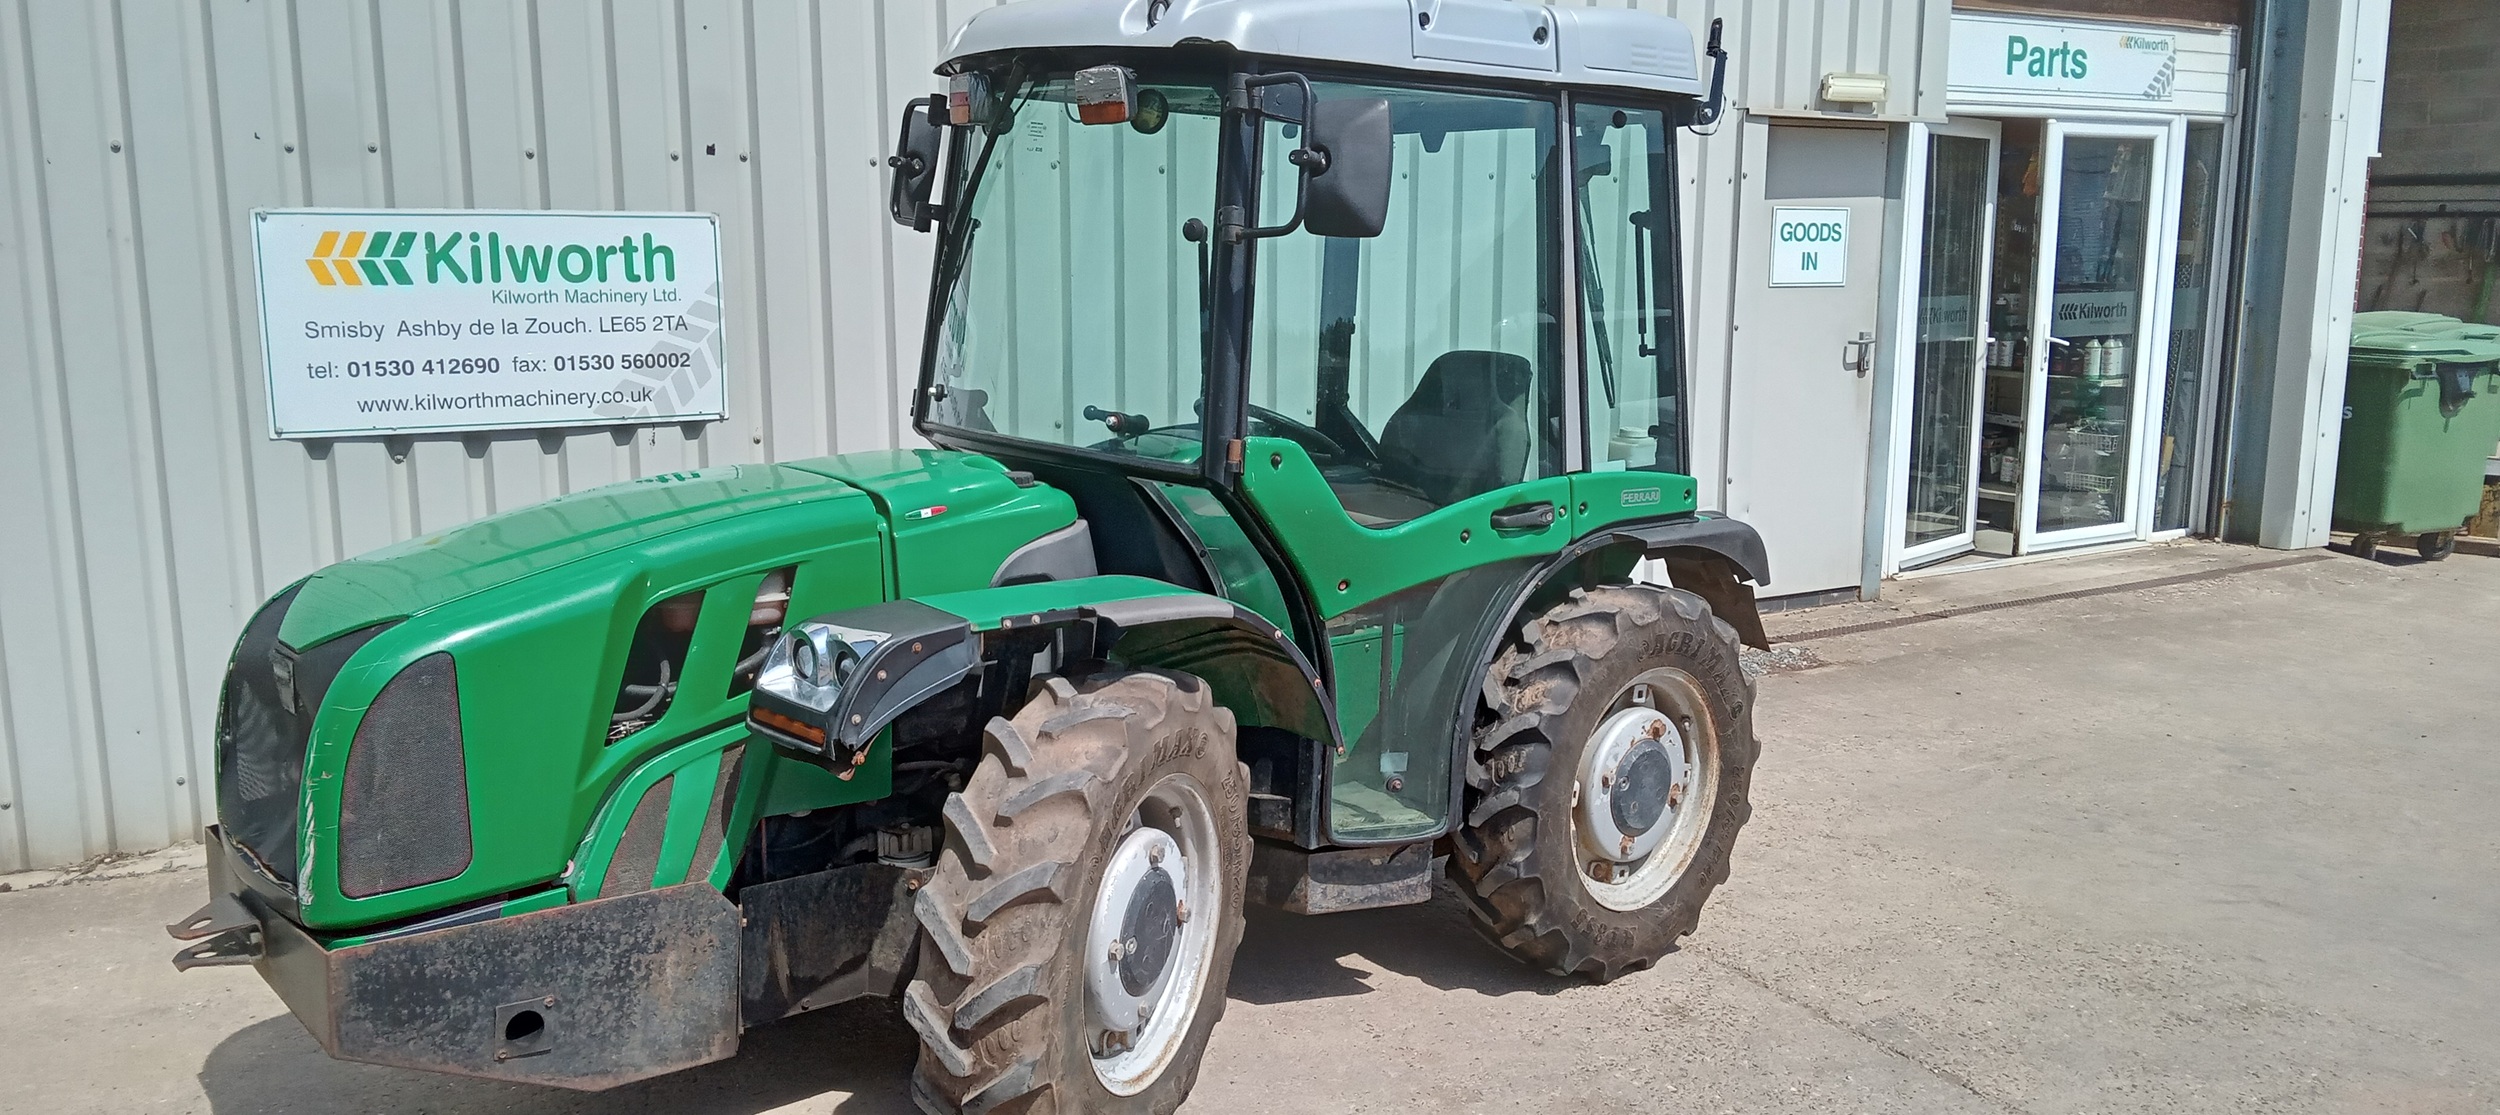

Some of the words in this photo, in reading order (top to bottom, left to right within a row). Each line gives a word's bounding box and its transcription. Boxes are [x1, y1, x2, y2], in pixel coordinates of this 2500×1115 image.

[2133, 37, 2169, 51] Kilworth
[2006, 35, 2088, 80] Parts
[1780, 222, 1842, 243] GOODS
[424, 231, 676, 284] Kilworth
[1801, 251, 1818, 271] IN
[491, 289, 559, 305] Kilworth
[564, 289, 648, 306] Machinery
[653, 288, 682, 302] Ltd.
[2079, 302, 2127, 319] Kilworth
[304, 320, 385, 342] Smisby
[397, 319, 462, 340] Ashby
[469, 318, 495, 336] de
[501, 318, 519, 335] la
[525, 316, 592, 335] Zouch.
[599, 316, 647, 333] LE65
[652, 315, 688, 332] 2TA
[307, 361, 339, 379] tel:
[347, 360, 415, 378] 01530
[421, 357, 500, 375] 412690
[512, 355, 547, 374] fax:
[553, 354, 615, 372] 01530
[620, 352, 691, 370] 560002
[356, 386, 653, 414] www.kilworthmachinery.co.uk
[1622, 491, 1660, 503] FERRARI
